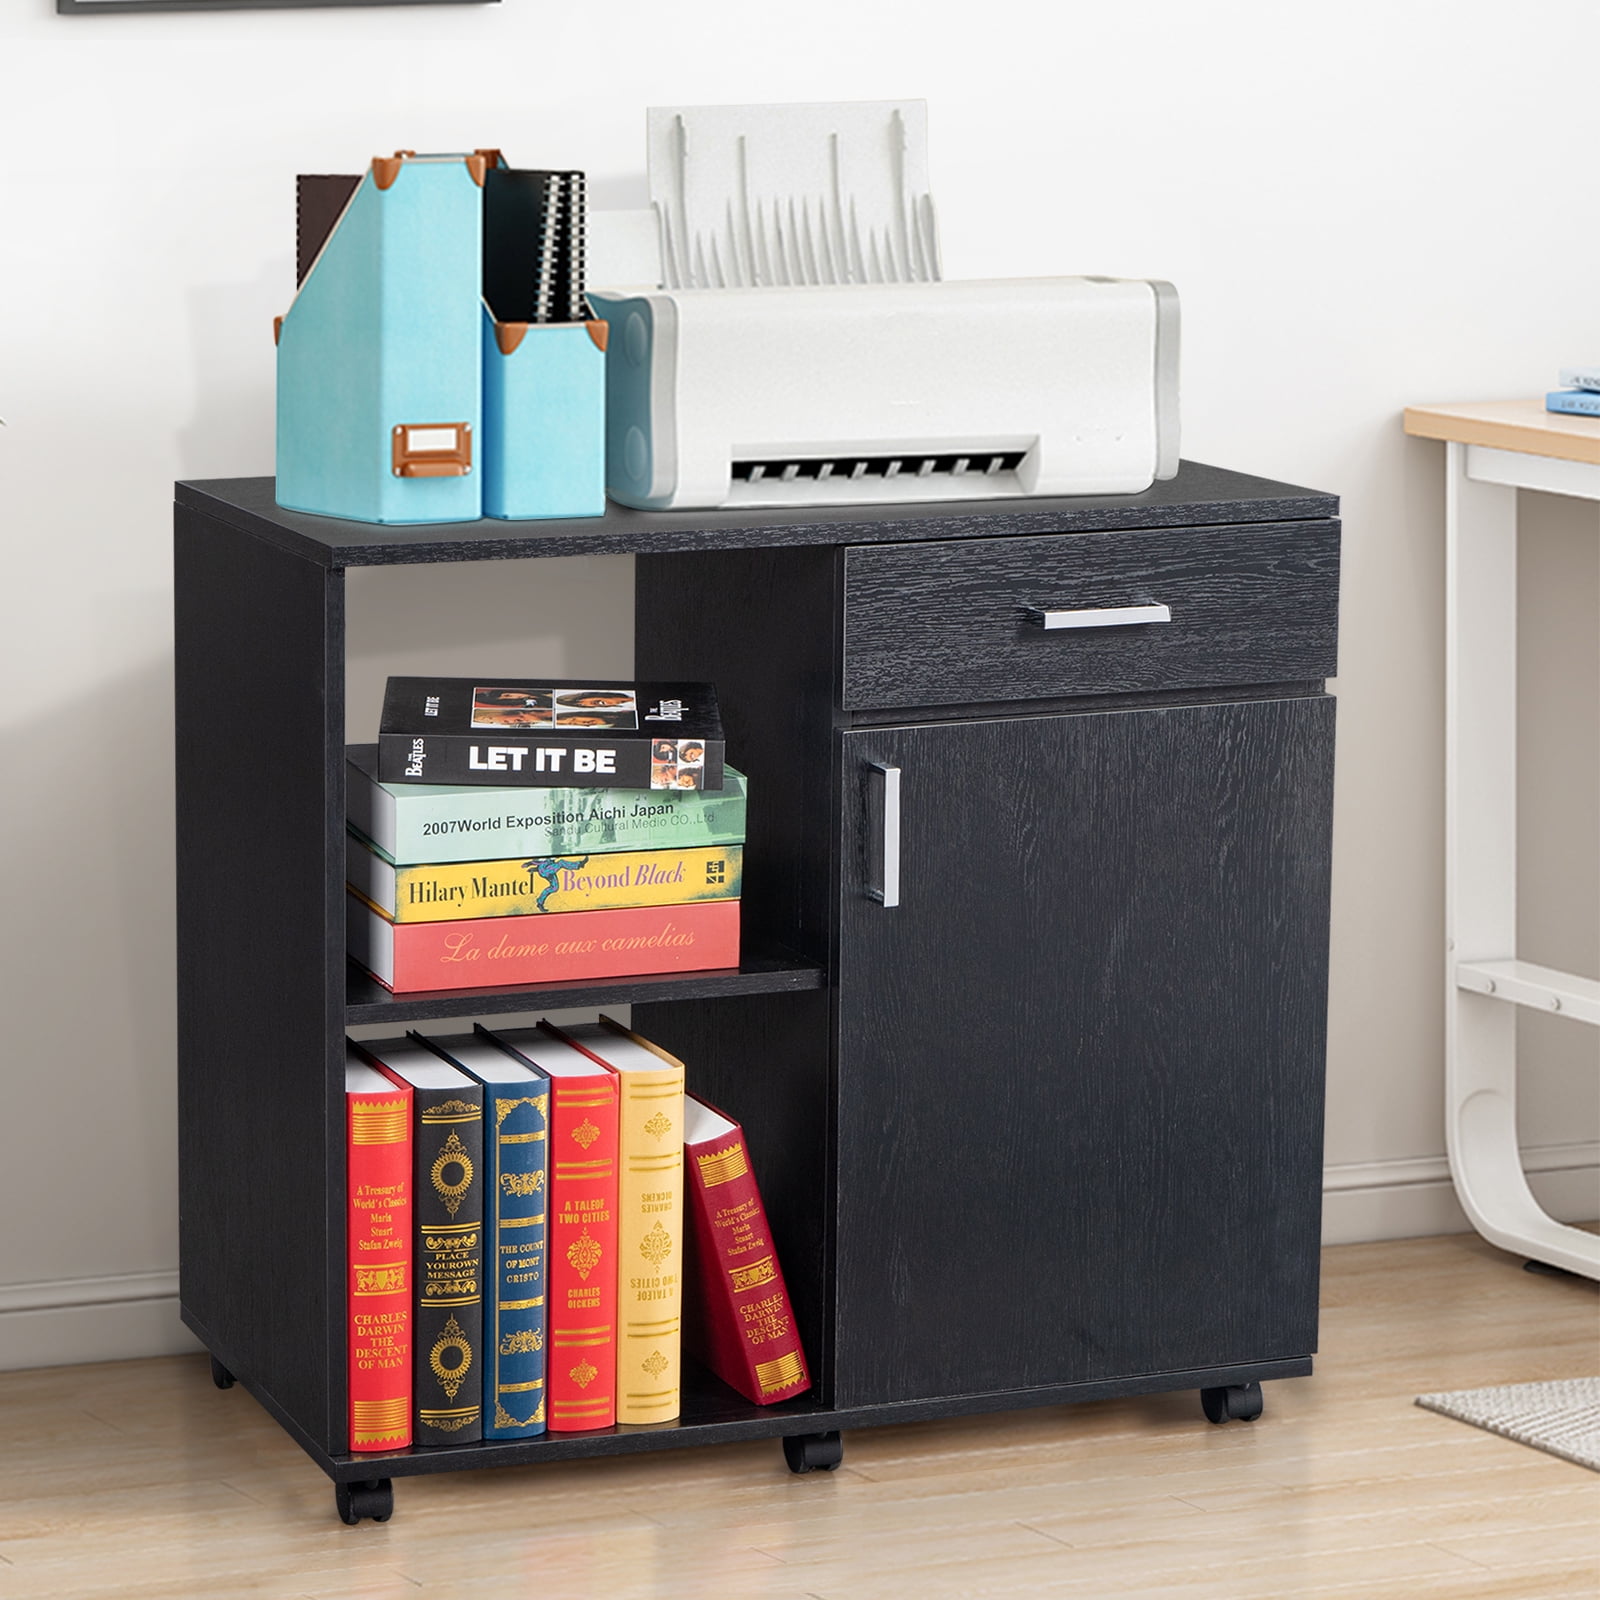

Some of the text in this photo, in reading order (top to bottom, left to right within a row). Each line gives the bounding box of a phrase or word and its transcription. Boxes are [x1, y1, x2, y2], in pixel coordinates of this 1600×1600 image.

[469, 746, 616, 774] LET IT BE
[506, 811, 584, 830] Exposition
[589, 805, 626, 821] Aichi
[630, 803, 674, 818] Japan
[544, 823, 582, 838] Sandu
[585, 818, 629, 834] Cultural
[563, 861, 687, 897] Beyond Black
[410, 872, 534, 907] Hilary Mantel
[440, 923, 695, 963] La dame aux camelias
[357, 1185, 363, 1196] A
[365, 1184, 396, 1197] Treasury
[565, 1201, 571, 1211] A
[559, 1210, 610, 1224] TWO CITIES
[371, 1227, 393, 1237] Stuart
[500, 1240, 544, 1254] THE COUNT
[435, 1251, 469, 1260] PLACE
[505, 1256, 540, 1269] OF MONT
[427, 1268, 476, 1279] MESSAGE
[506, 1271, 539, 1284] CRISTO
[630, 1278, 661, 1289] CITIES
[567, 1287, 601, 1298] CHARLES
[567, 1298, 601, 1309] DICKENS
[740, 1292, 783, 1314] CHARLES
[354, 1311, 407, 1325] CHARLES
[744, 1301, 783, 1322] DARWIN
[758, 1313, 777, 1326] THE
[357, 1323, 405, 1336] DARWIN
[745, 1315, 789, 1338] DESCENT
[370, 1336, 394, 1347] THE
[752, 1325, 788, 1345] OF MAN
[355, 1344, 408, 1358] DESCENT
[358, 1357, 404, 1370] OF MAN
